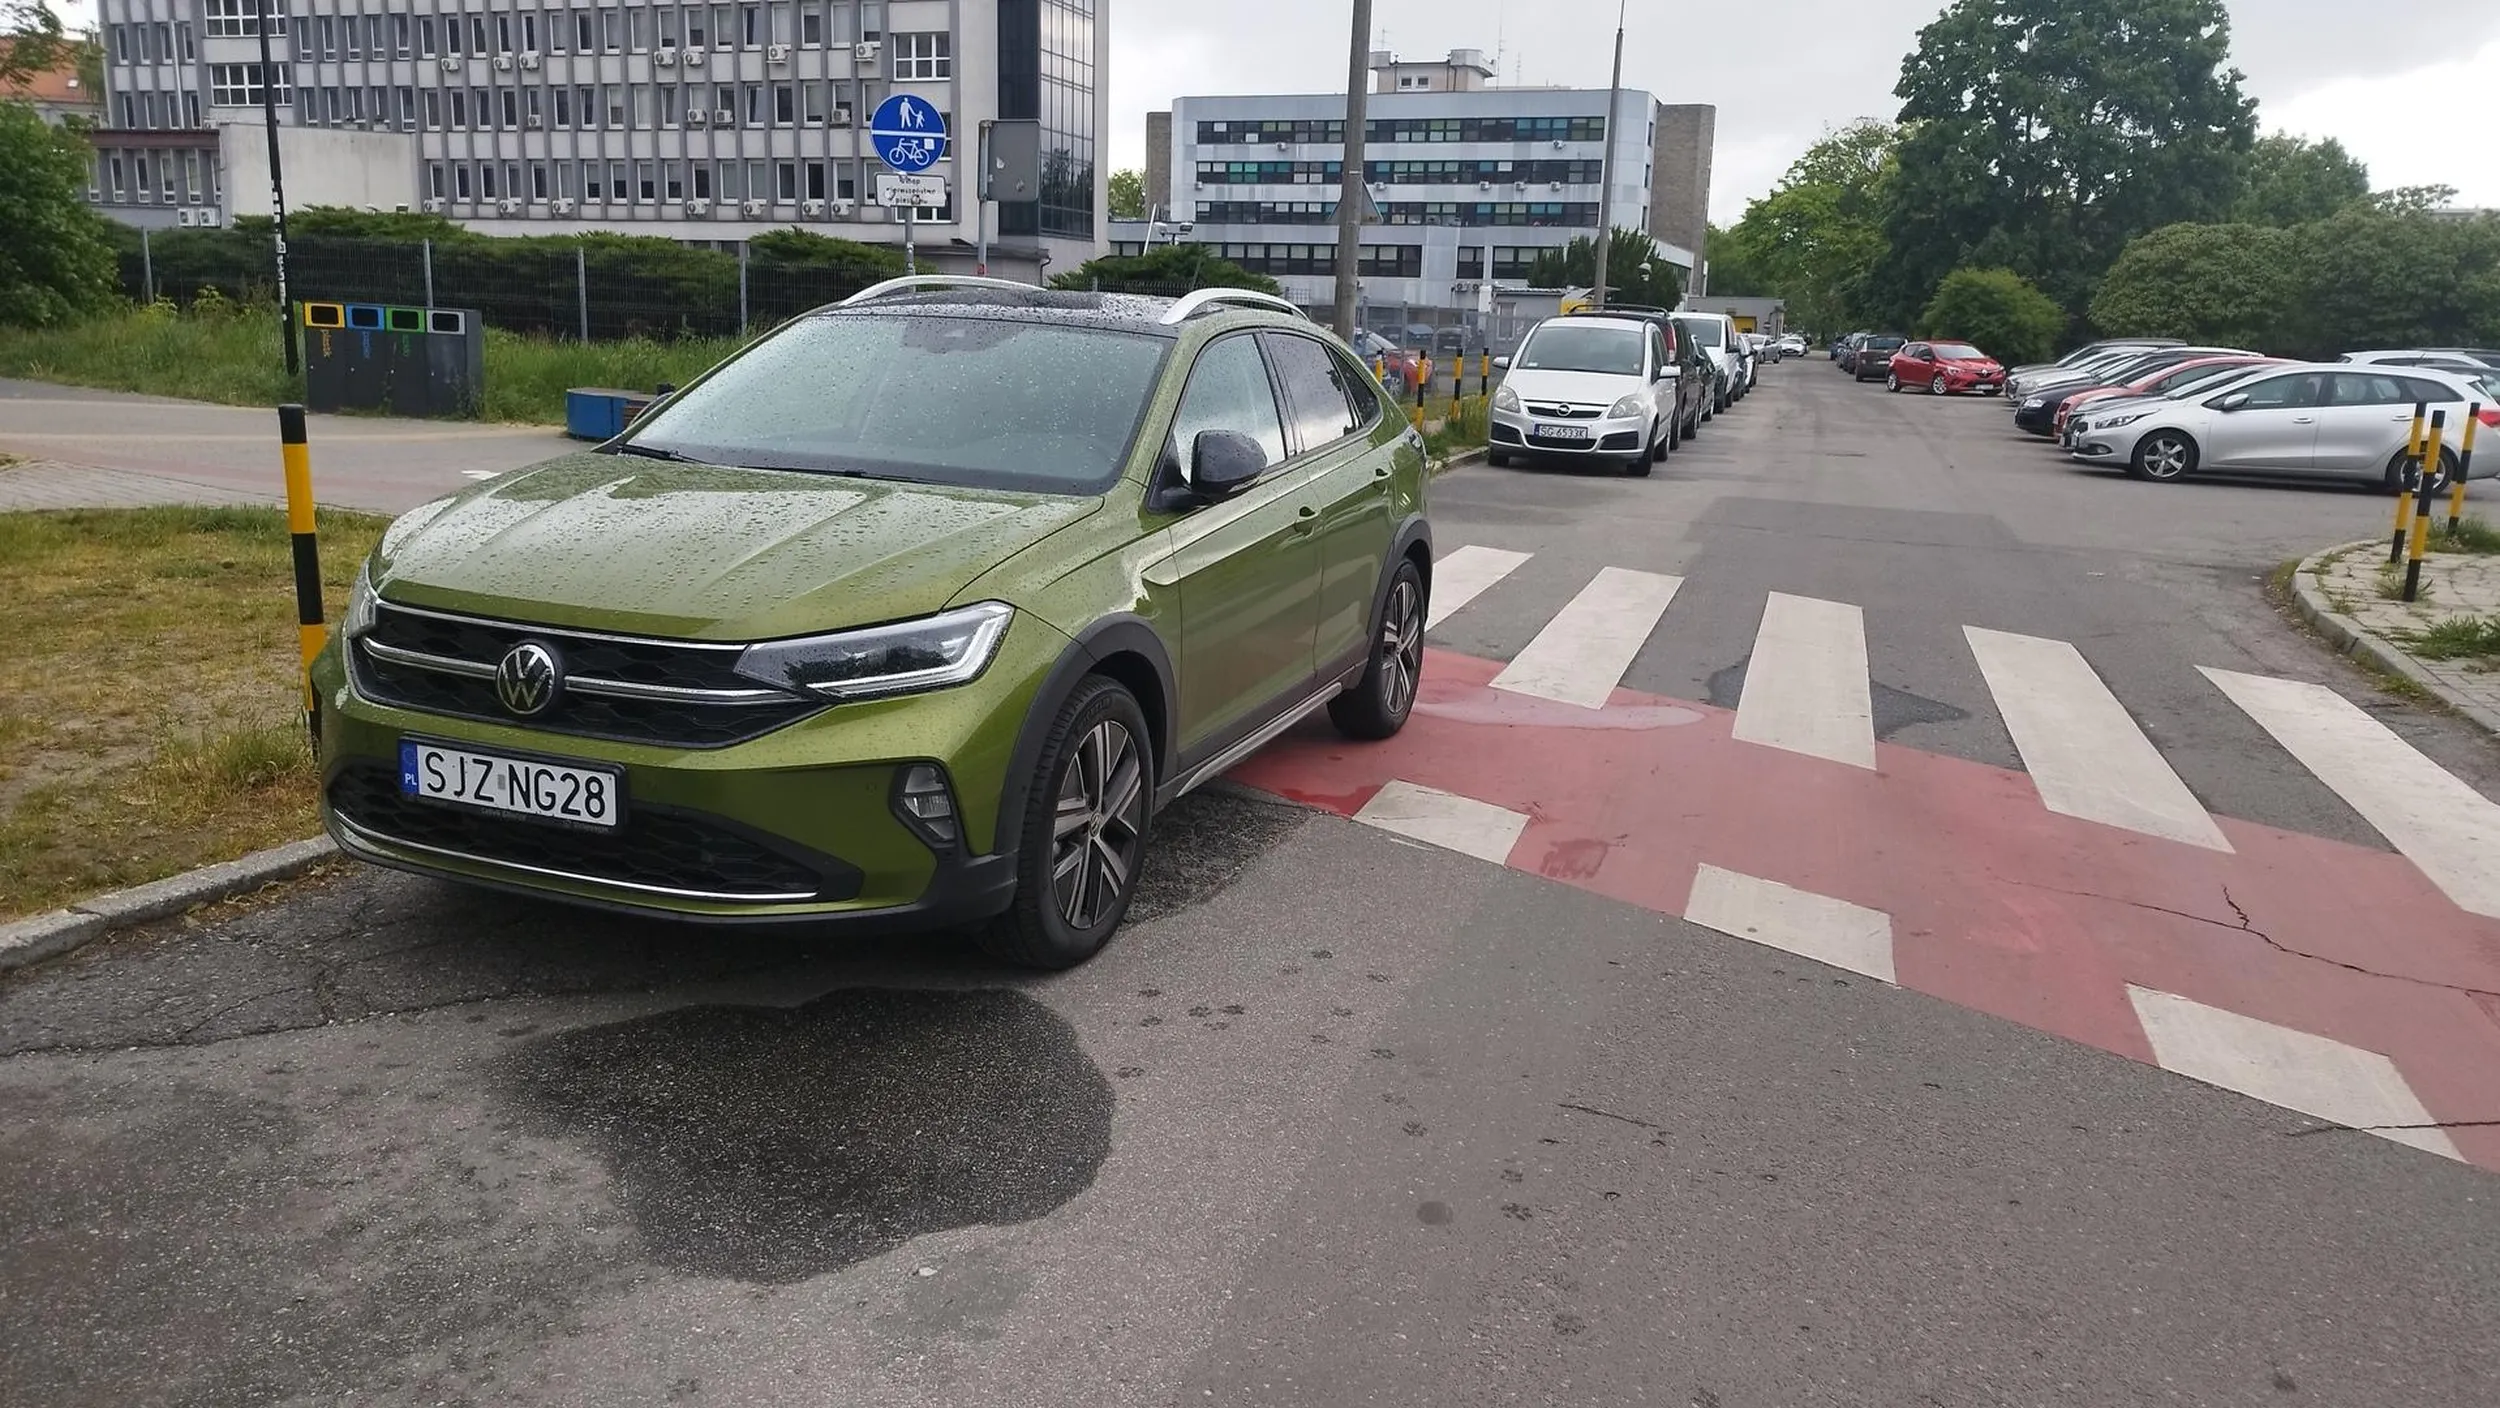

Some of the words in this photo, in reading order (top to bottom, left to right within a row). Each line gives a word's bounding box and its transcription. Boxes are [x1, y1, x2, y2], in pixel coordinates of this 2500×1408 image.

[1540, 426, 1554, 437] SG
[404, 773, 418, 786] PL
[425, 751, 495, 803] SJZ
[508, 763, 606, 819] NG28
